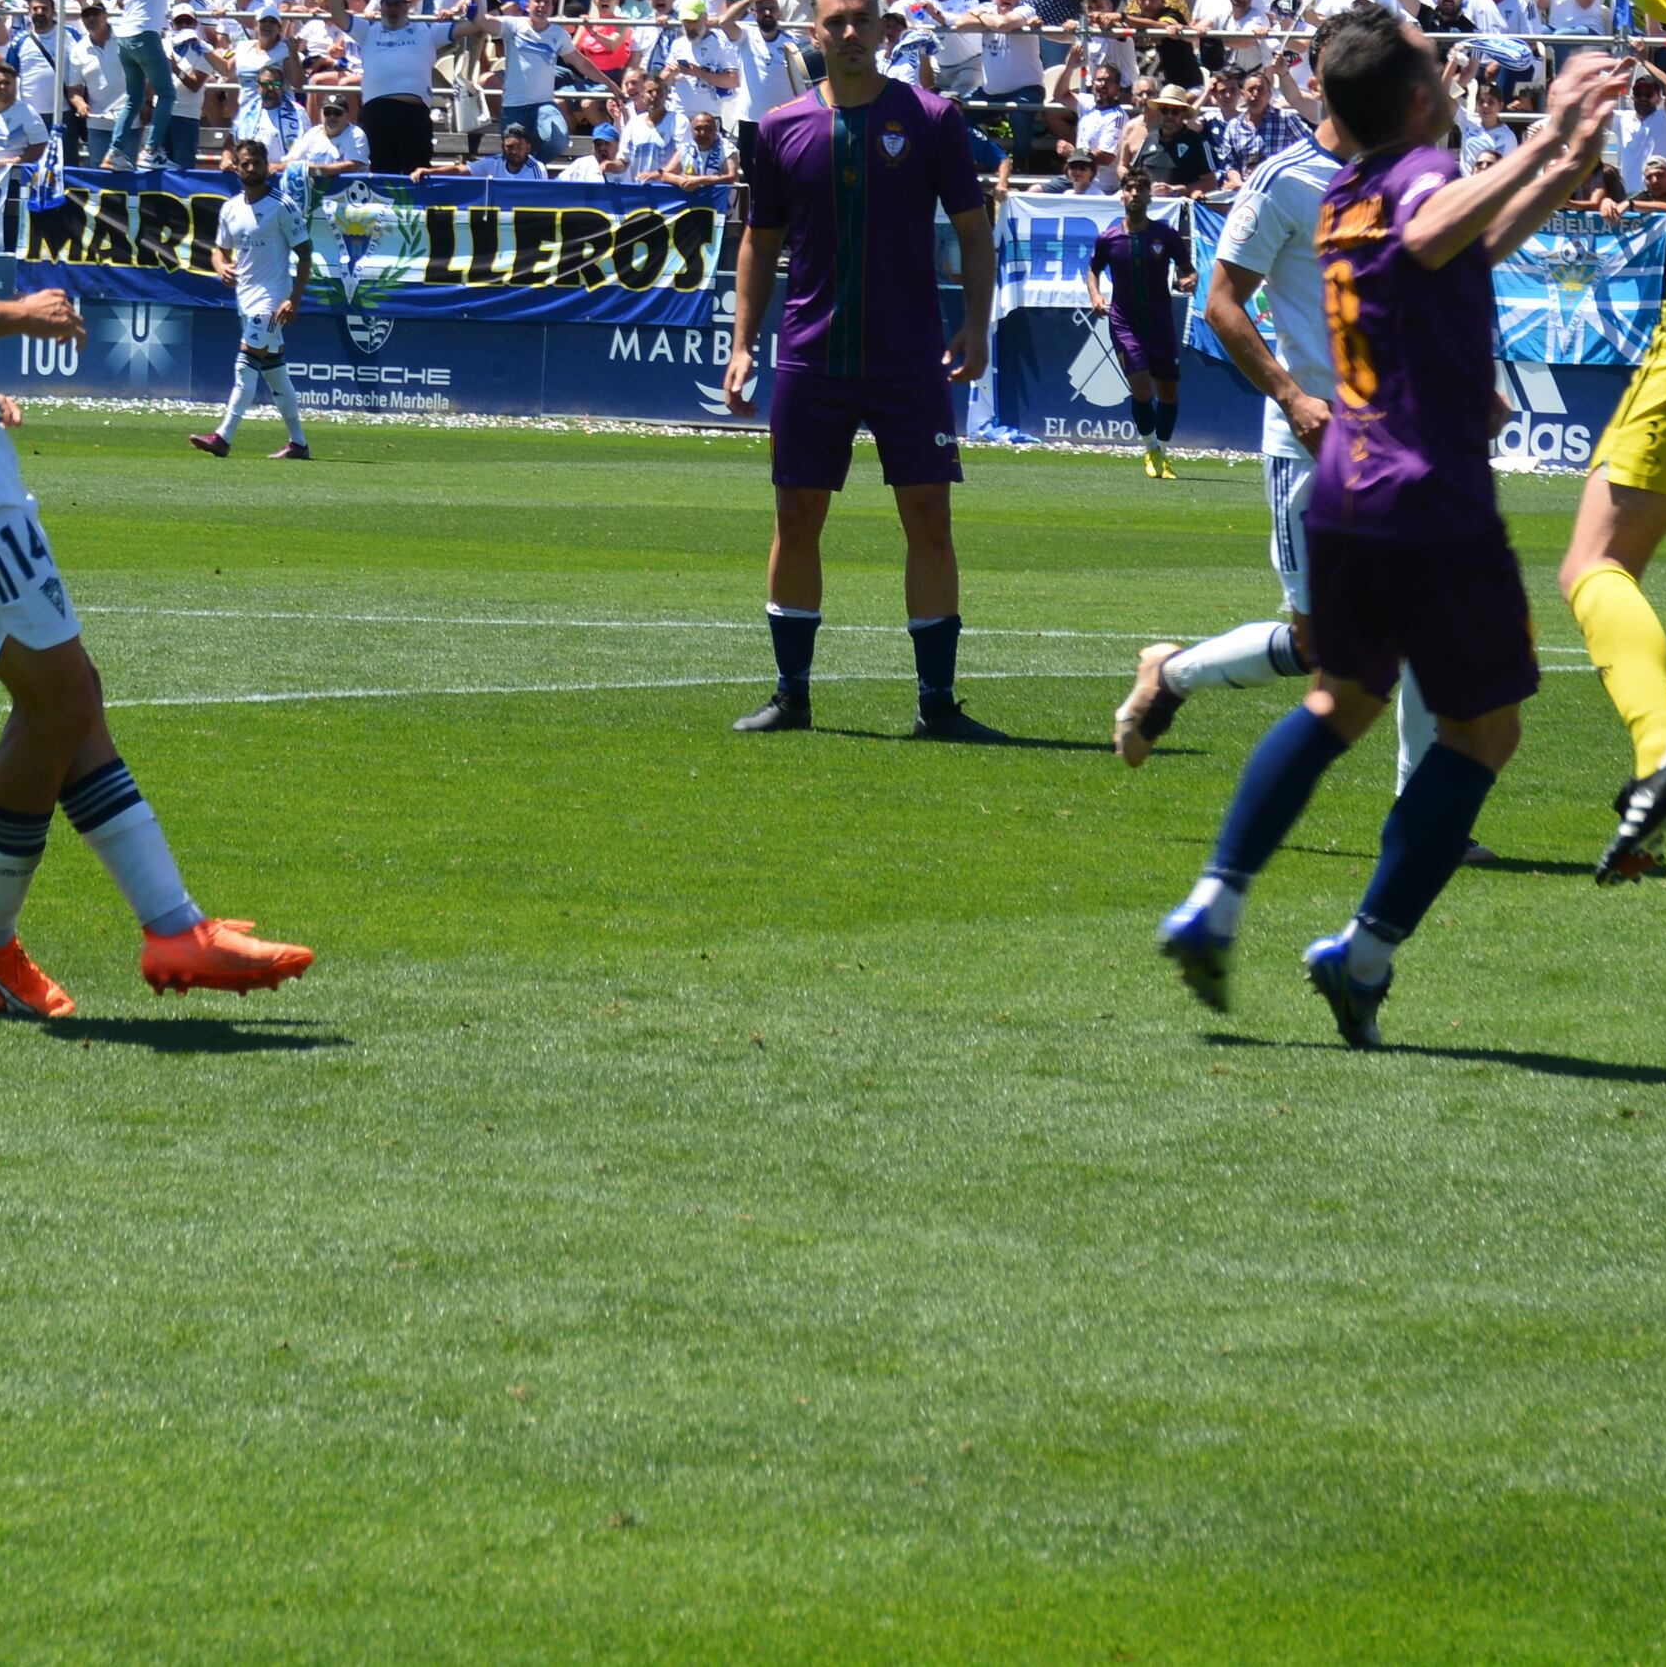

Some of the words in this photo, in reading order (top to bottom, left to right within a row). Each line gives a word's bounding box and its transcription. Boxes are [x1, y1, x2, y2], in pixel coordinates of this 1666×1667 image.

[422, 205, 719, 294] LLEROS
[285, 363, 452, 387] PORSCHE
[294, 389, 330, 408] entro
[331, 390, 387, 409] Porsche
[389, 392, 450, 411] Marbella
[1044, 417, 1073, 438] EL
